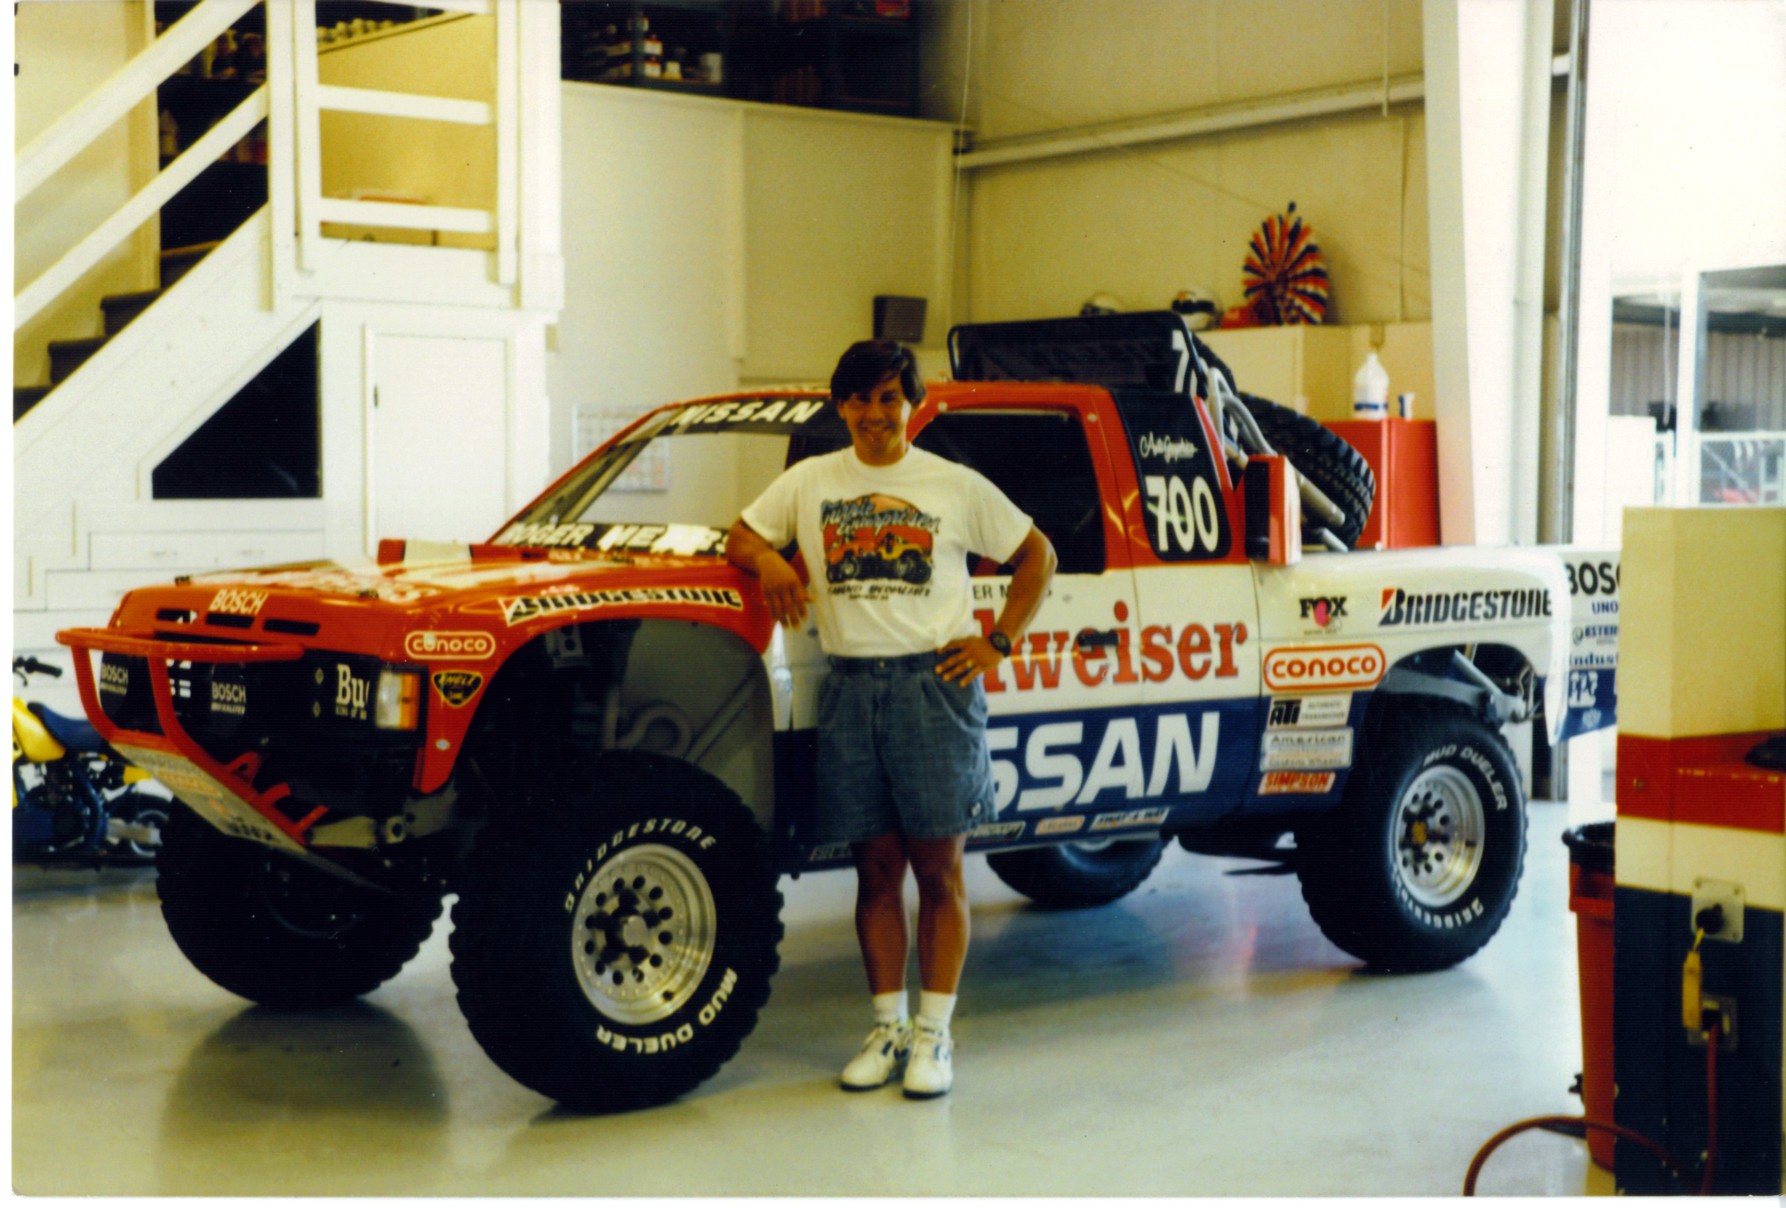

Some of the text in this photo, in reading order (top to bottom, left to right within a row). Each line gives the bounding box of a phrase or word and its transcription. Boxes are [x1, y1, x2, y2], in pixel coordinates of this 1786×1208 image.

[668, 401, 824, 426] NISSAN
[1145, 475, 1219, 552] 700
[493, 522, 727, 555] ROGER MER
[1567, 562, 1619, 595] BOS
[208, 589, 268, 614] BOSCH
[508, 587, 743, 622] BRIDGESTONE
[1299, 596, 1348, 618] FOX
[1378, 587, 1552, 626] BRIDGESTONE
[412, 637, 487, 652] conoco
[101, 663, 129, 684] BOSCH
[1272, 655, 1376, 678] conoco
[211, 682, 247, 703] BOSCH
[336, 663, 370, 708] Bu
[1270, 700, 1302, 726] ATI
[1272, 735, 1345, 744] American
[1266, 772, 1331, 791] SIMPSON
[1423, 745, 1507, 810] MUD DUELER
[564, 818, 717, 913] BRIDGESTONE
[596, 967, 738, 1054] MUD DUELER
